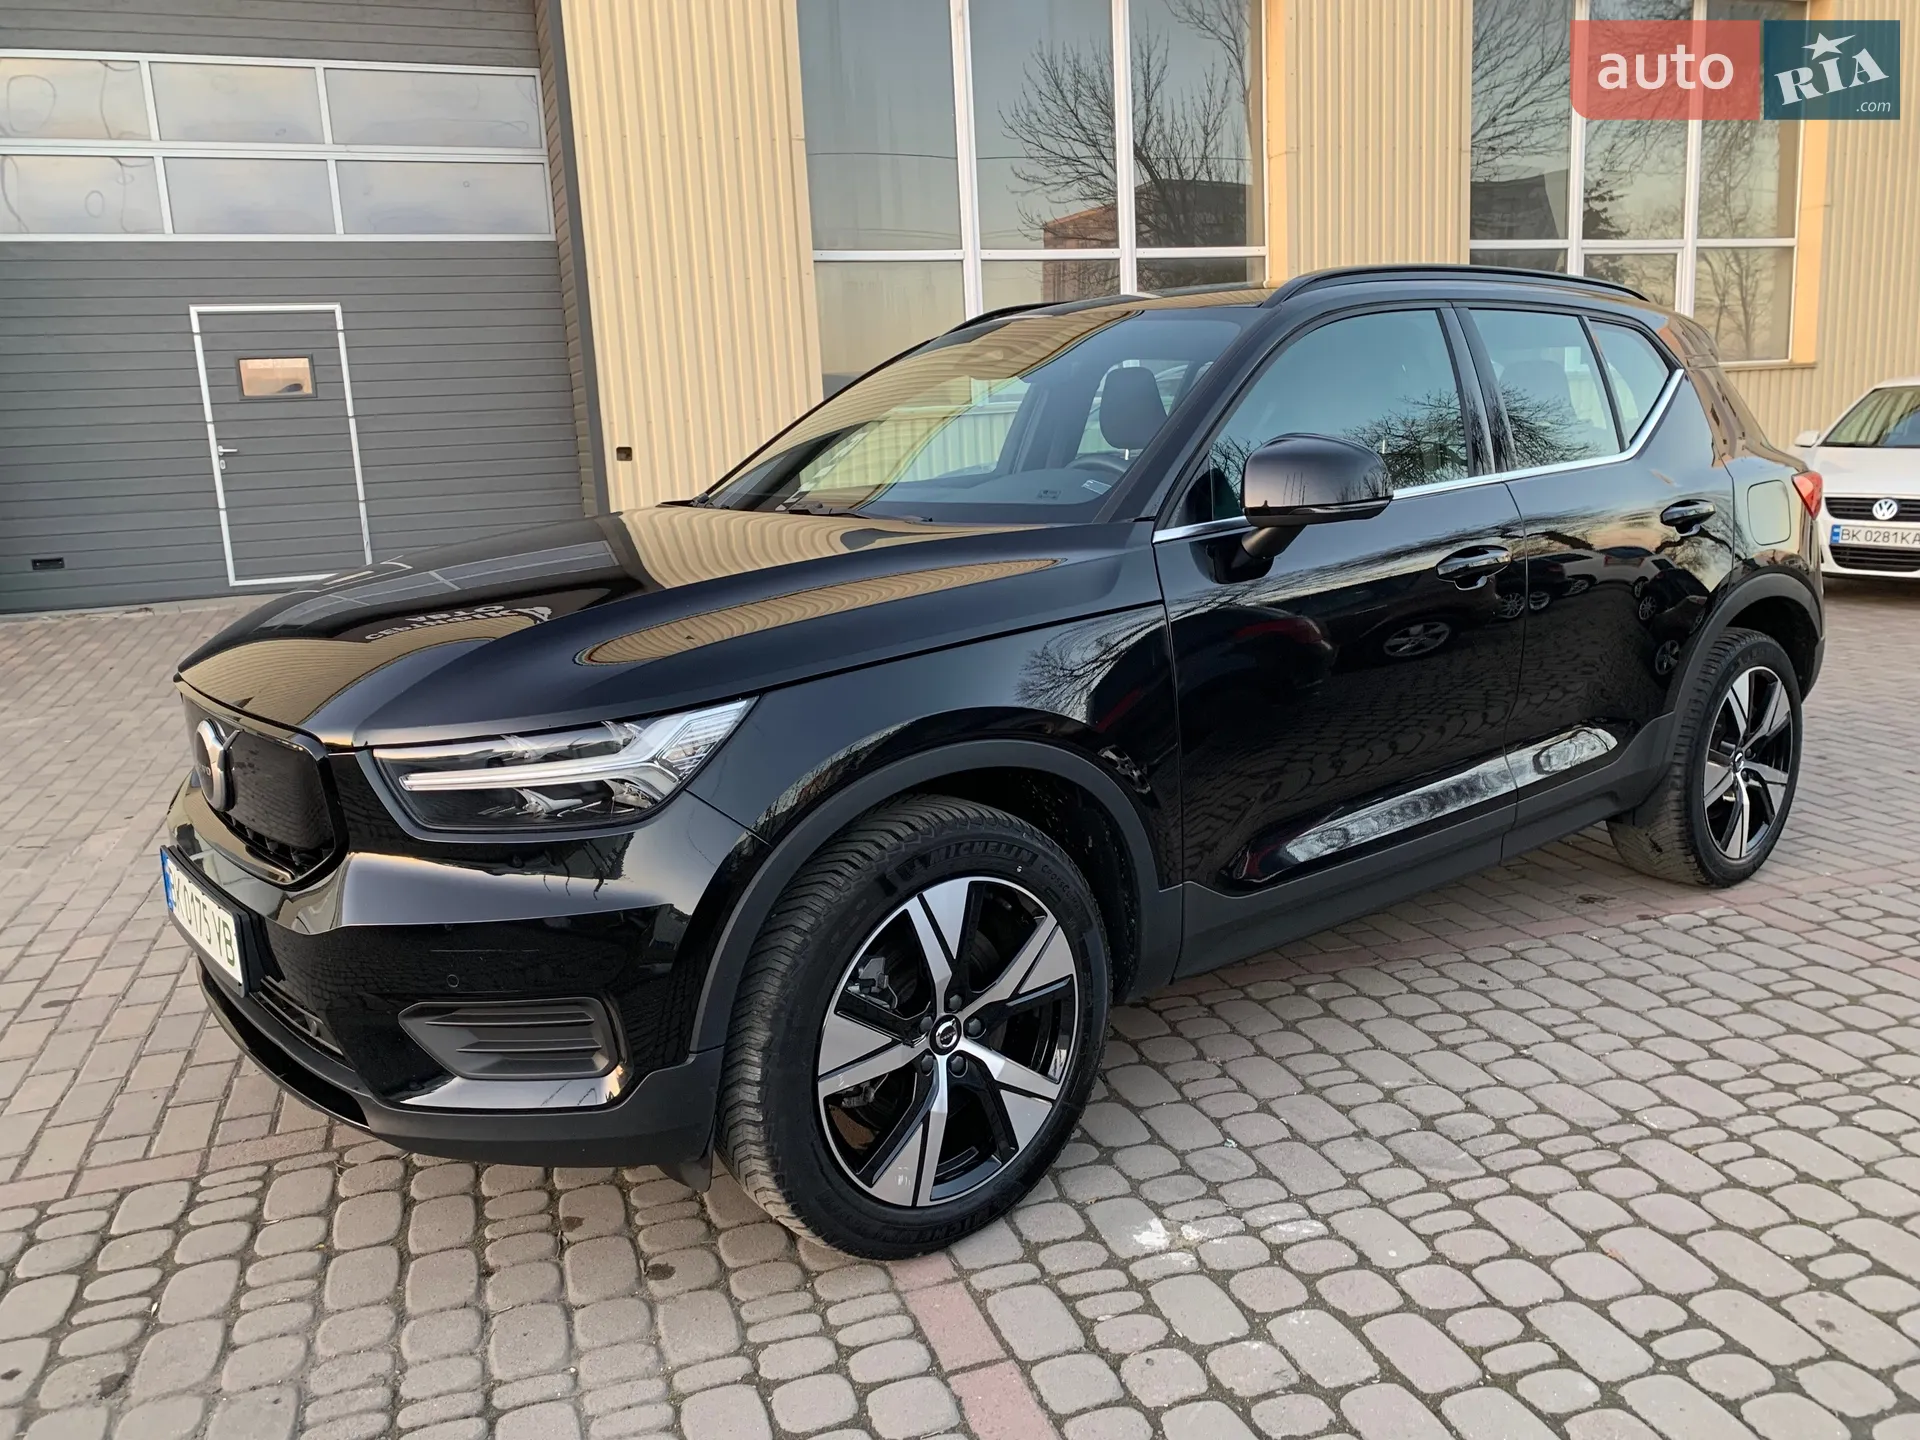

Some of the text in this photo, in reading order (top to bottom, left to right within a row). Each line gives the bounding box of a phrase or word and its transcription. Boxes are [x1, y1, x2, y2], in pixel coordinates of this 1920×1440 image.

[1841, 528, 1862, 542] BK
[1864, 530, 1898, 543] 0281
[928, 841, 1034, 865] MICHELIN
